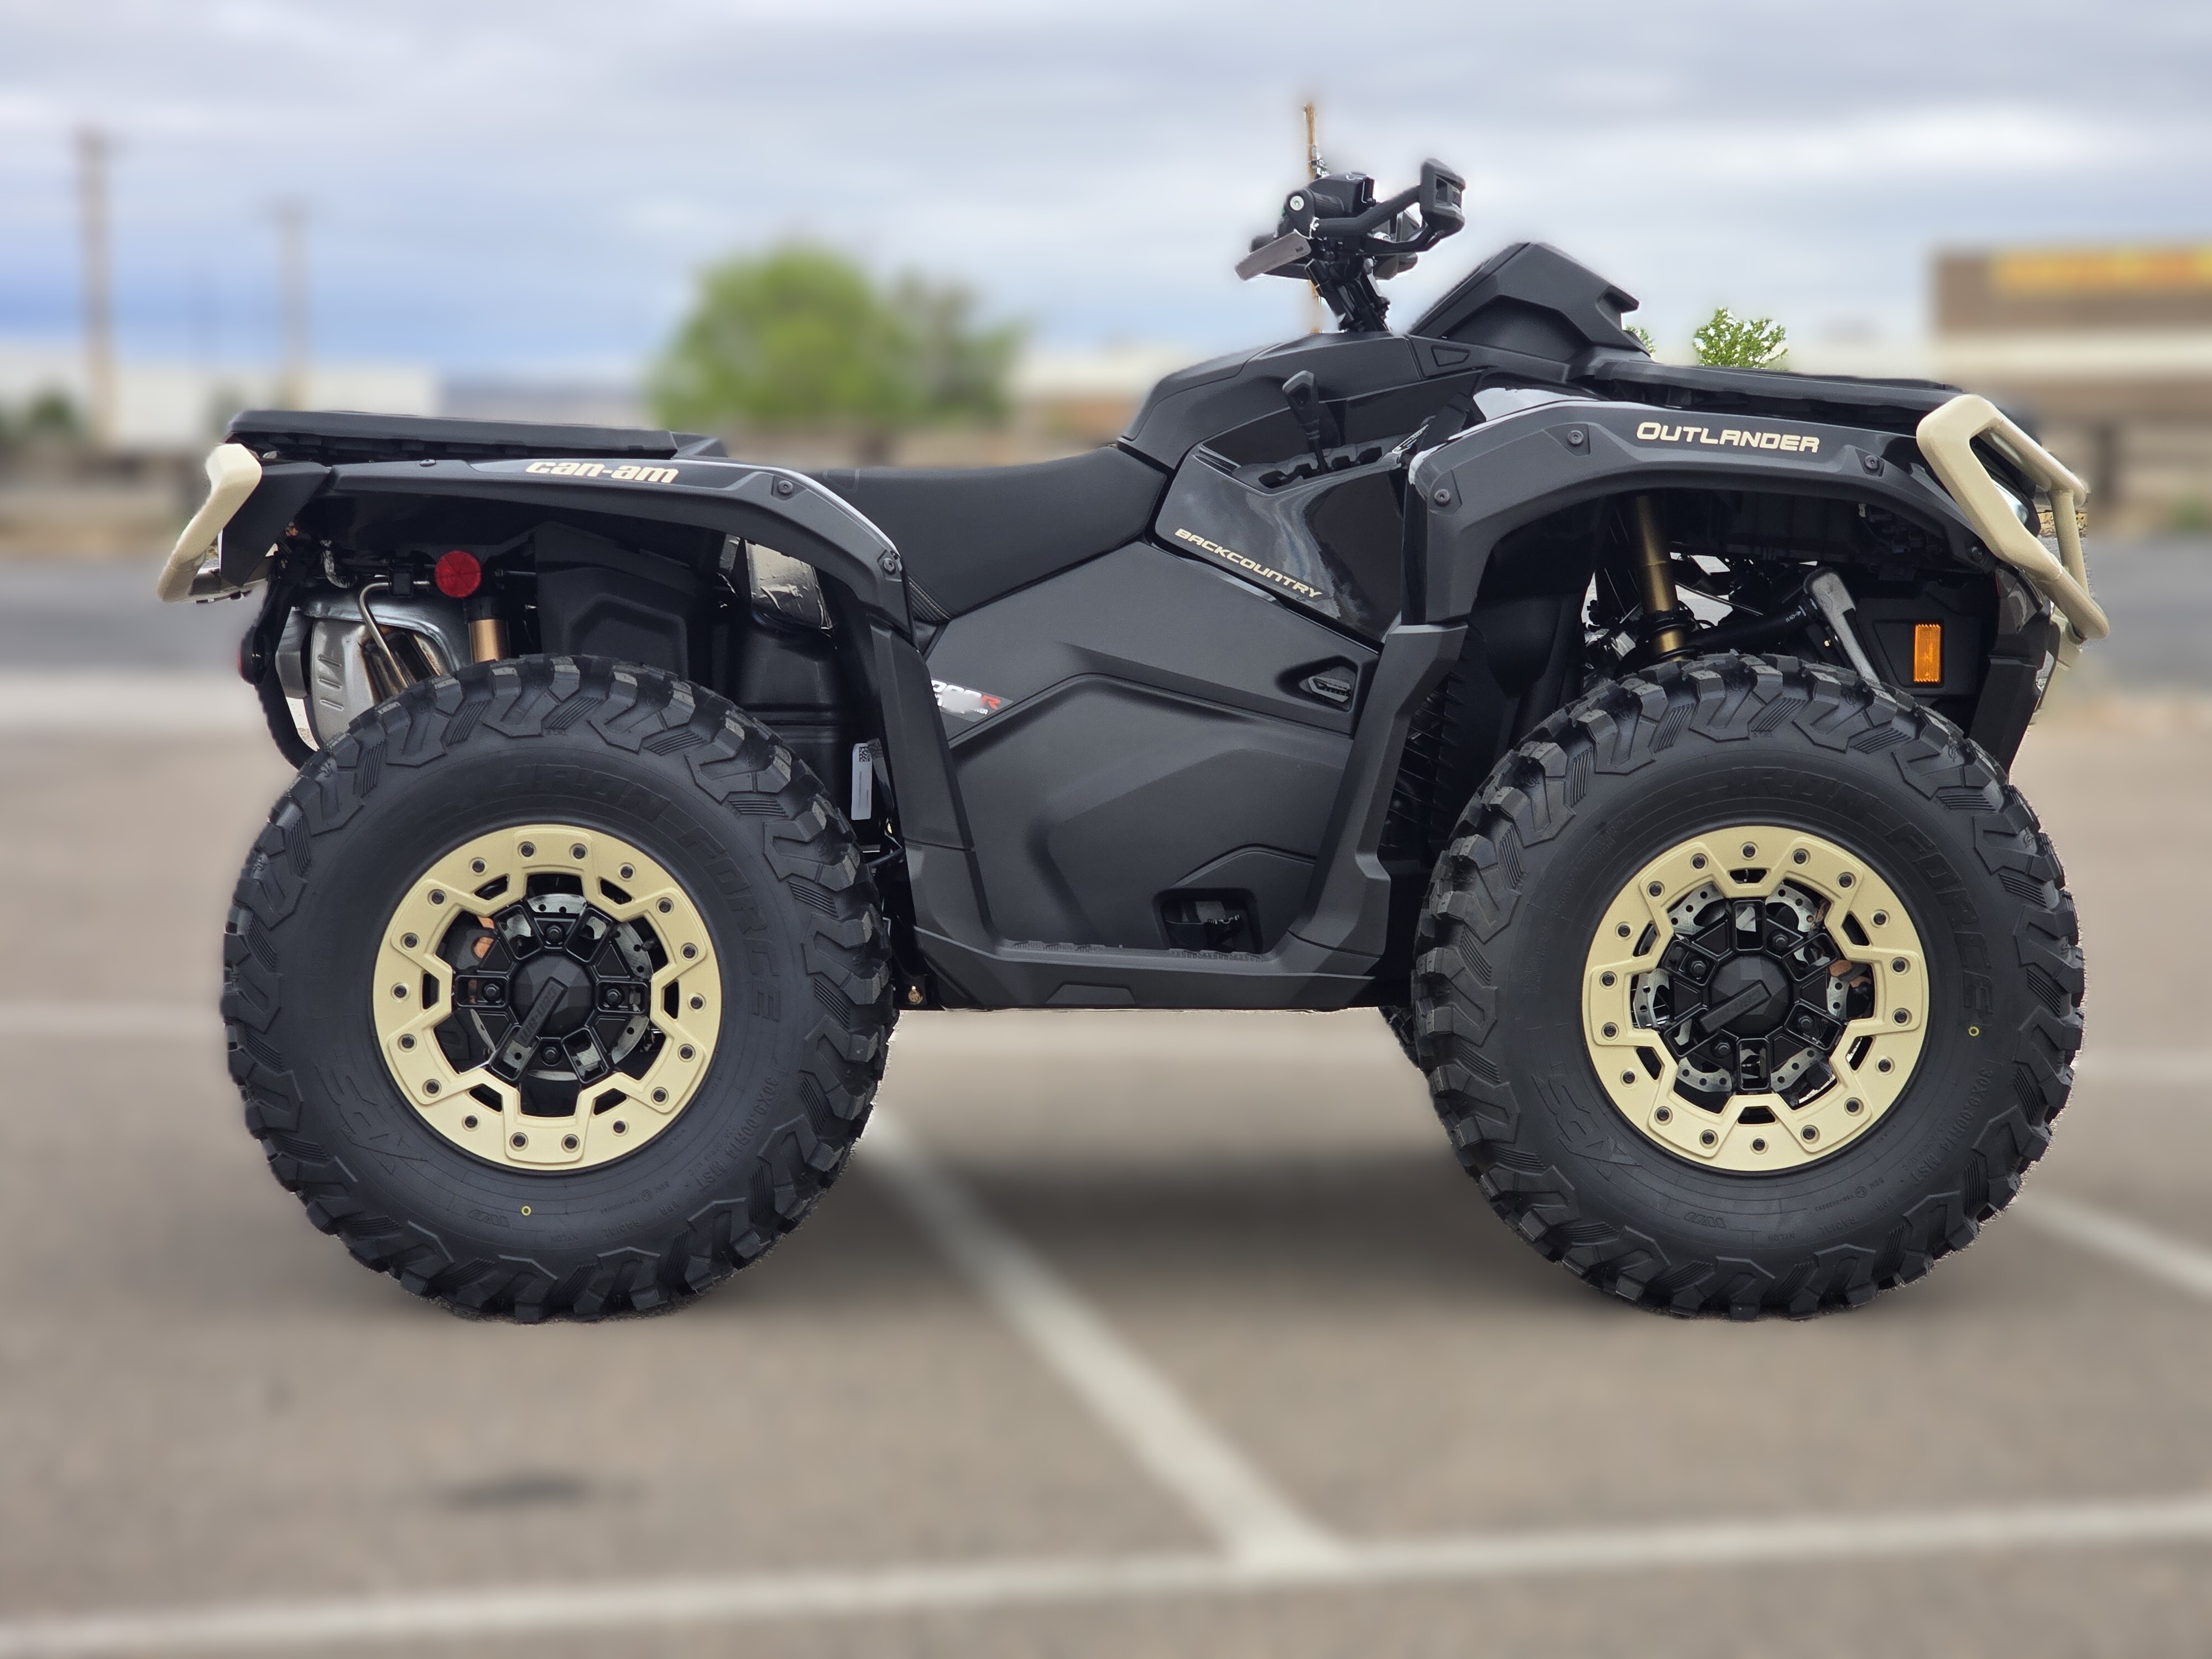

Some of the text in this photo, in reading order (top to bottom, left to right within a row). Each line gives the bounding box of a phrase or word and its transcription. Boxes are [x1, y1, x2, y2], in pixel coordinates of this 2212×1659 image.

[525, 461, 679, 483] can-am
[1636, 422, 1820, 453] OUTLANDER
[1175, 528, 1323, 598] BACKCOUNTRY
[677, 826, 781, 1022] FORCE
[1884, 822, 1993, 1014] FORCE
